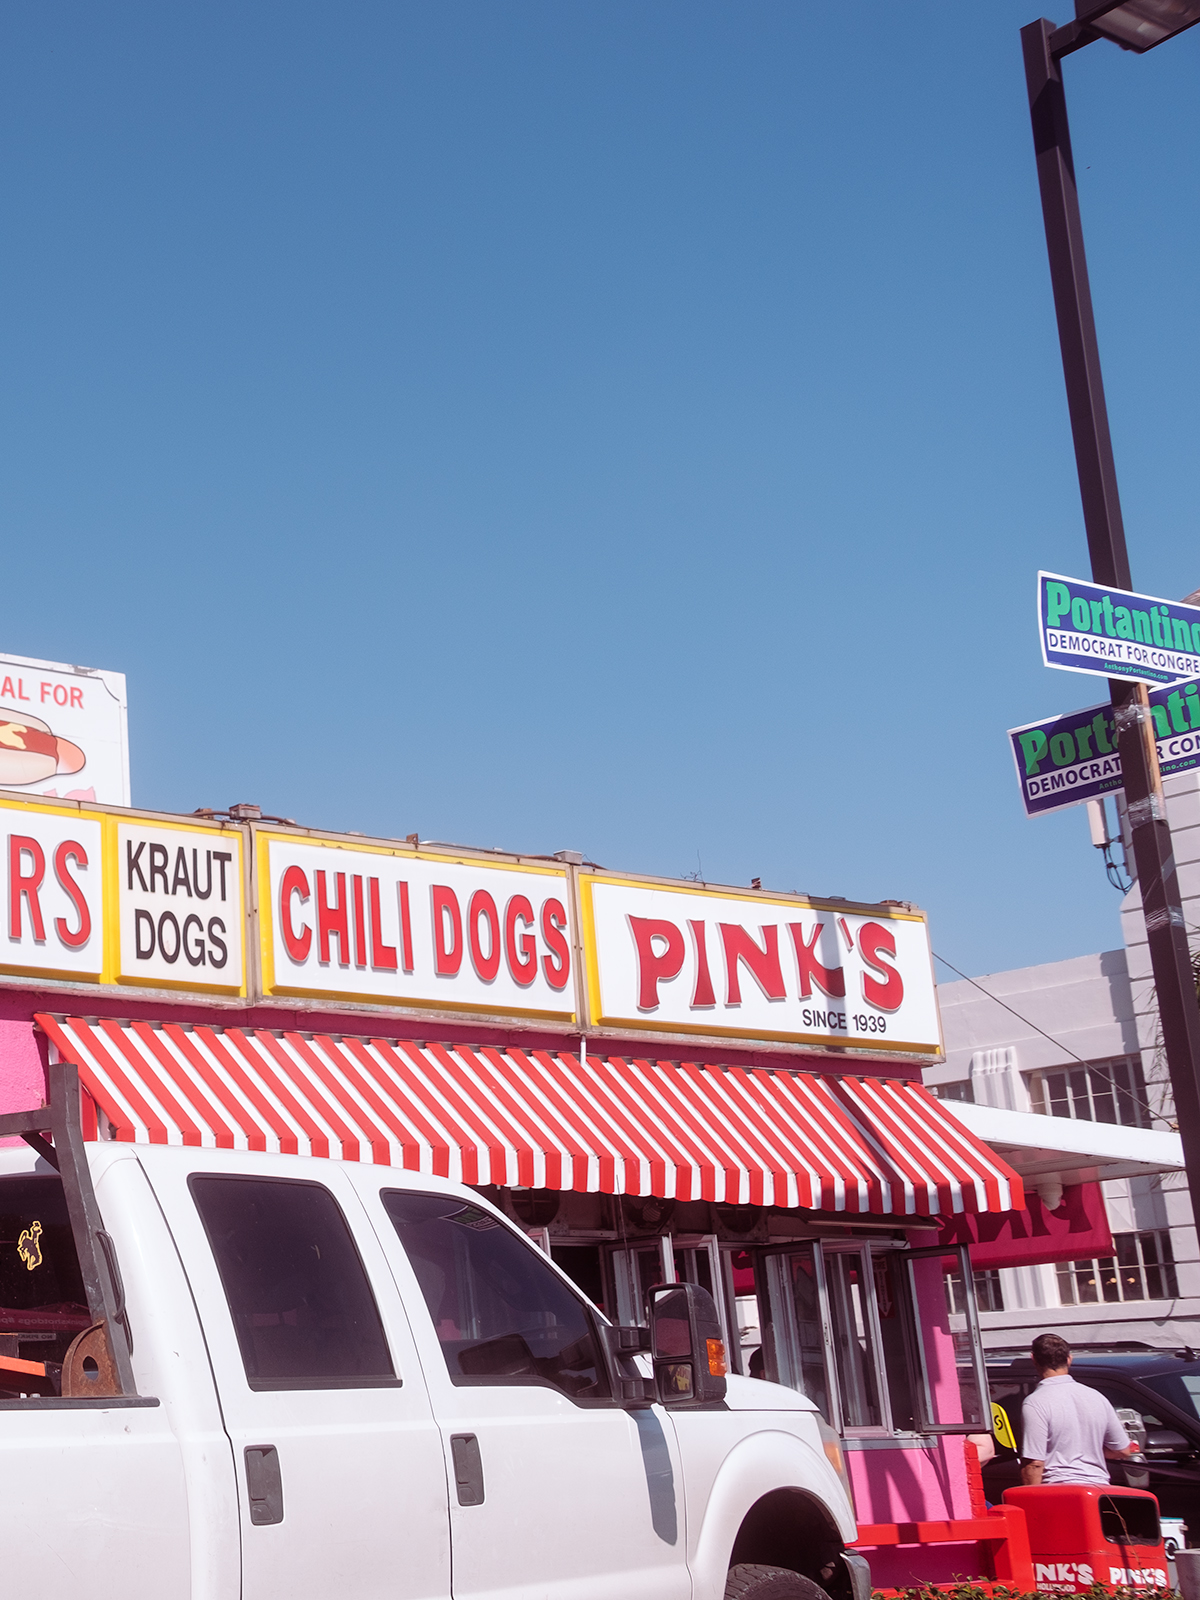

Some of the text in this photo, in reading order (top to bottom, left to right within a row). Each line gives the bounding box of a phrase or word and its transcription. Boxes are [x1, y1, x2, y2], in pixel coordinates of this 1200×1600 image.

[1049, 632, 1123, 659] DEMOCRAT
[1126, 645, 1149, 664] FOR
[1103, 662, 1169, 680] AnthonyPortantino.com
[39, 682, 85, 710] FOR
[1018, 683, 1200, 776] Portnti
[1028, 757, 1121, 797] DEMOCRAT
[126, 839, 232, 902] KRAUT
[134, 908, 228, 969] DOGS
[280, 864, 570, 991] CHILI DOGS
[626, 912, 905, 1013] PINK'S
[802, 1008, 887, 1034] SINCE 1939
[1109, 1566, 1168, 1587] PINK'S
